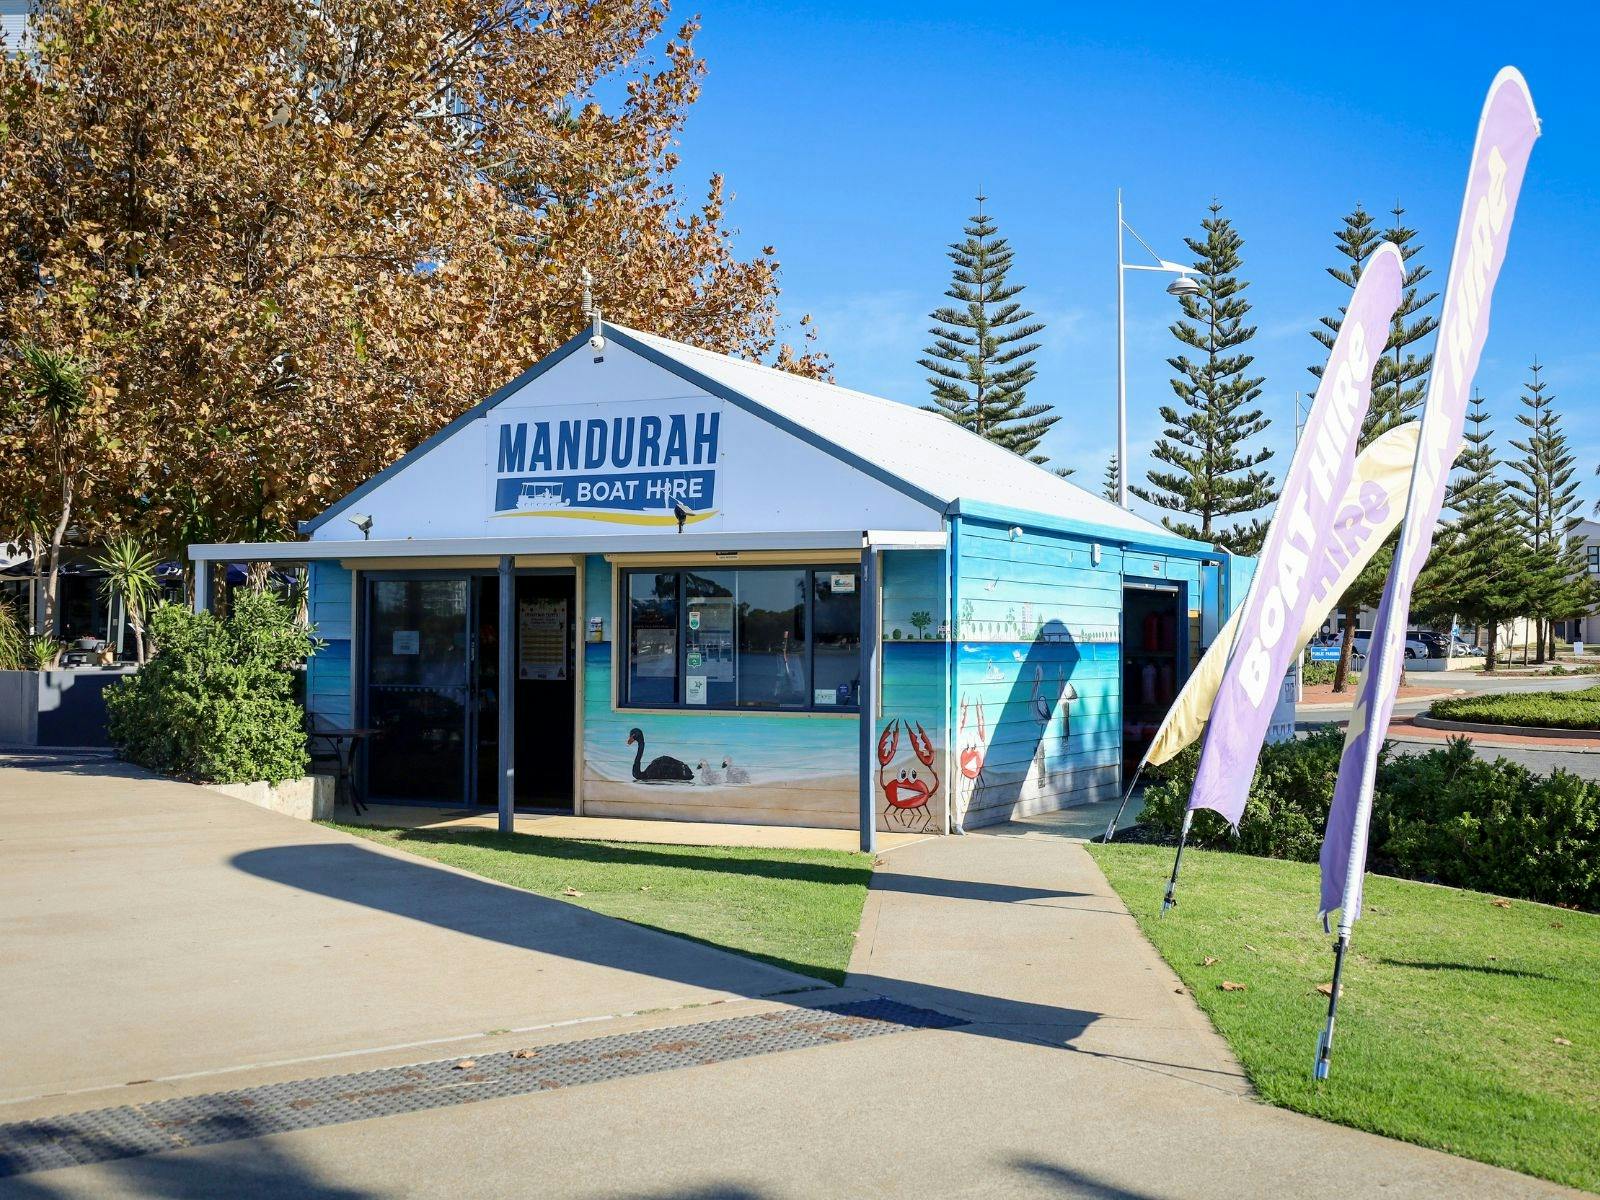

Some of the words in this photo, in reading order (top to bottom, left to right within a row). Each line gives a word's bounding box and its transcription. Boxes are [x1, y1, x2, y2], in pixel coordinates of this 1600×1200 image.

[497, 412, 720, 473] MANDURAH
[577, 480, 640, 502] BOAT
[1238, 485, 1319, 708] BOAT
